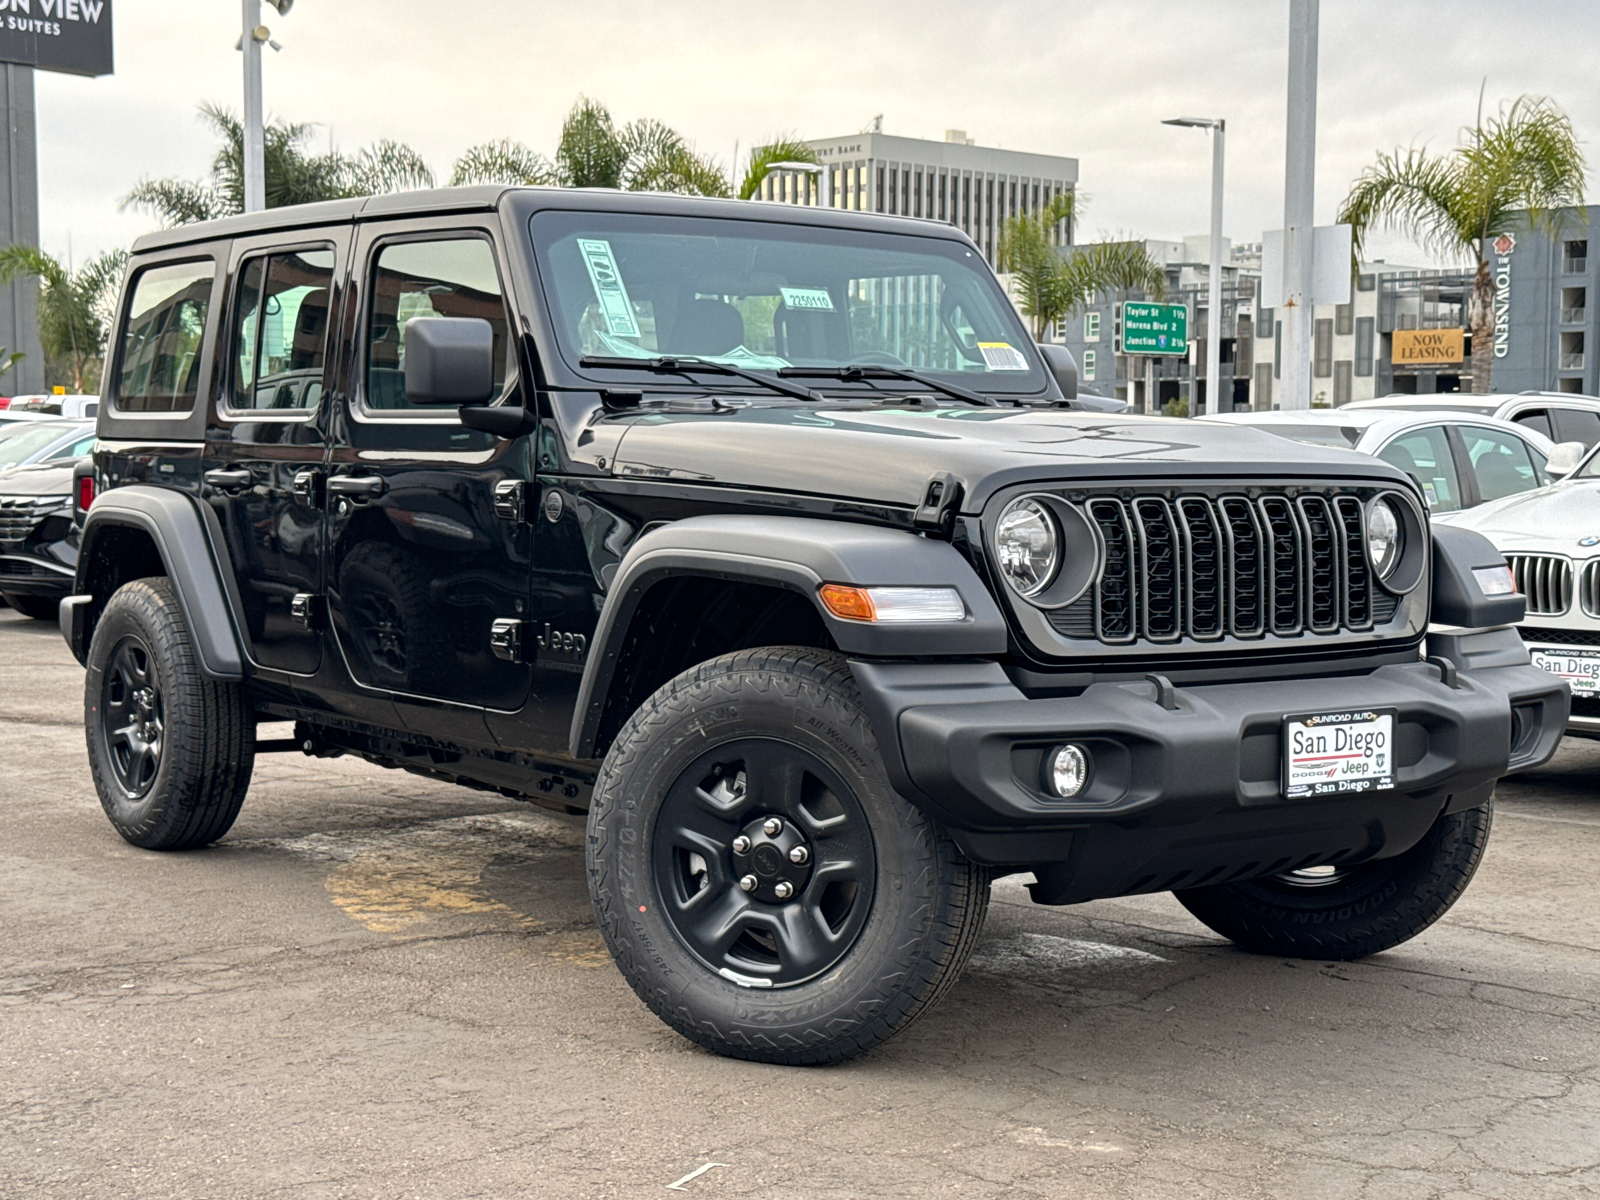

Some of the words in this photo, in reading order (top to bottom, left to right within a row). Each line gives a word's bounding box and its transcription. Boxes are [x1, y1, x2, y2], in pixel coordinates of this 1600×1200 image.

[40, 0, 104, 24] VIEW
[8, 16, 61, 36] SUITES
[838, 145, 862, 154] BANK
[790, 295, 829, 308] 2250110
[1127, 306, 1149, 318] Taylor
[1151, 308, 1159, 317] St
[1494, 264, 1510, 358] TOWNSEND
[1126, 320, 1151, 330] Morena
[1152, 321, 1168, 331] Blvd
[1171, 322, 1177, 331] 2
[1126, 336, 1156, 345] Junction
[1413, 335, 1443, 346] NOW
[1402, 346, 1455, 359] LEASING
[537, 622, 586, 660] Jeep
[1536, 657, 1561, 671] San
[1567, 659, 1600, 680] Dieg
[1573, 678, 1596, 688] Jeep
[1312, 715, 1351, 723] SUNROAD
[1352, 712, 1373, 720] AUTO
[806, 717, 868, 768] All-Weather
[1293, 730, 1327, 755] San
[1334, 725, 1385, 758] Diego
[1292, 770, 1330, 778] DODGE
[1341, 760, 1369, 775] Jeep
[1315, 783, 1336, 793] San
[1338, 780, 1370, 792] Diego
[632, 920, 674, 977] 245/75R17
